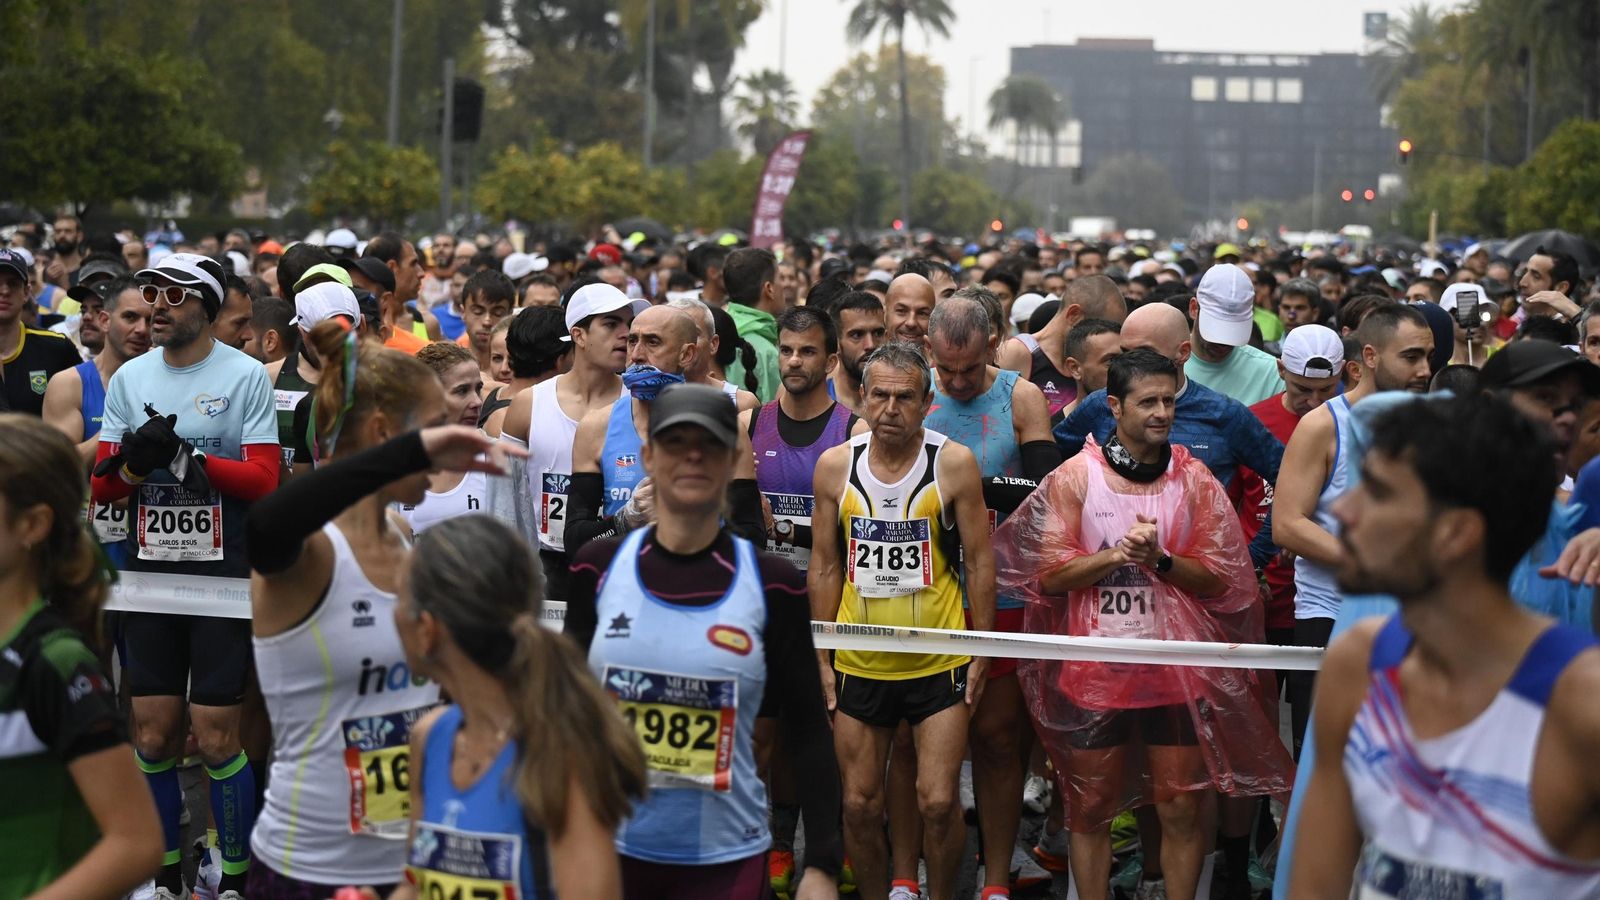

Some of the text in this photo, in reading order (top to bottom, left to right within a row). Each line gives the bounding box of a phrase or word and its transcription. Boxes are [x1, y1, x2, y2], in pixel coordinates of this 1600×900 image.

[779, 496, 804, 504] MEDIA
[147, 510, 211, 534] 2066
[885, 522, 912, 530] MEDIA
[857, 544, 920, 570] 2183
